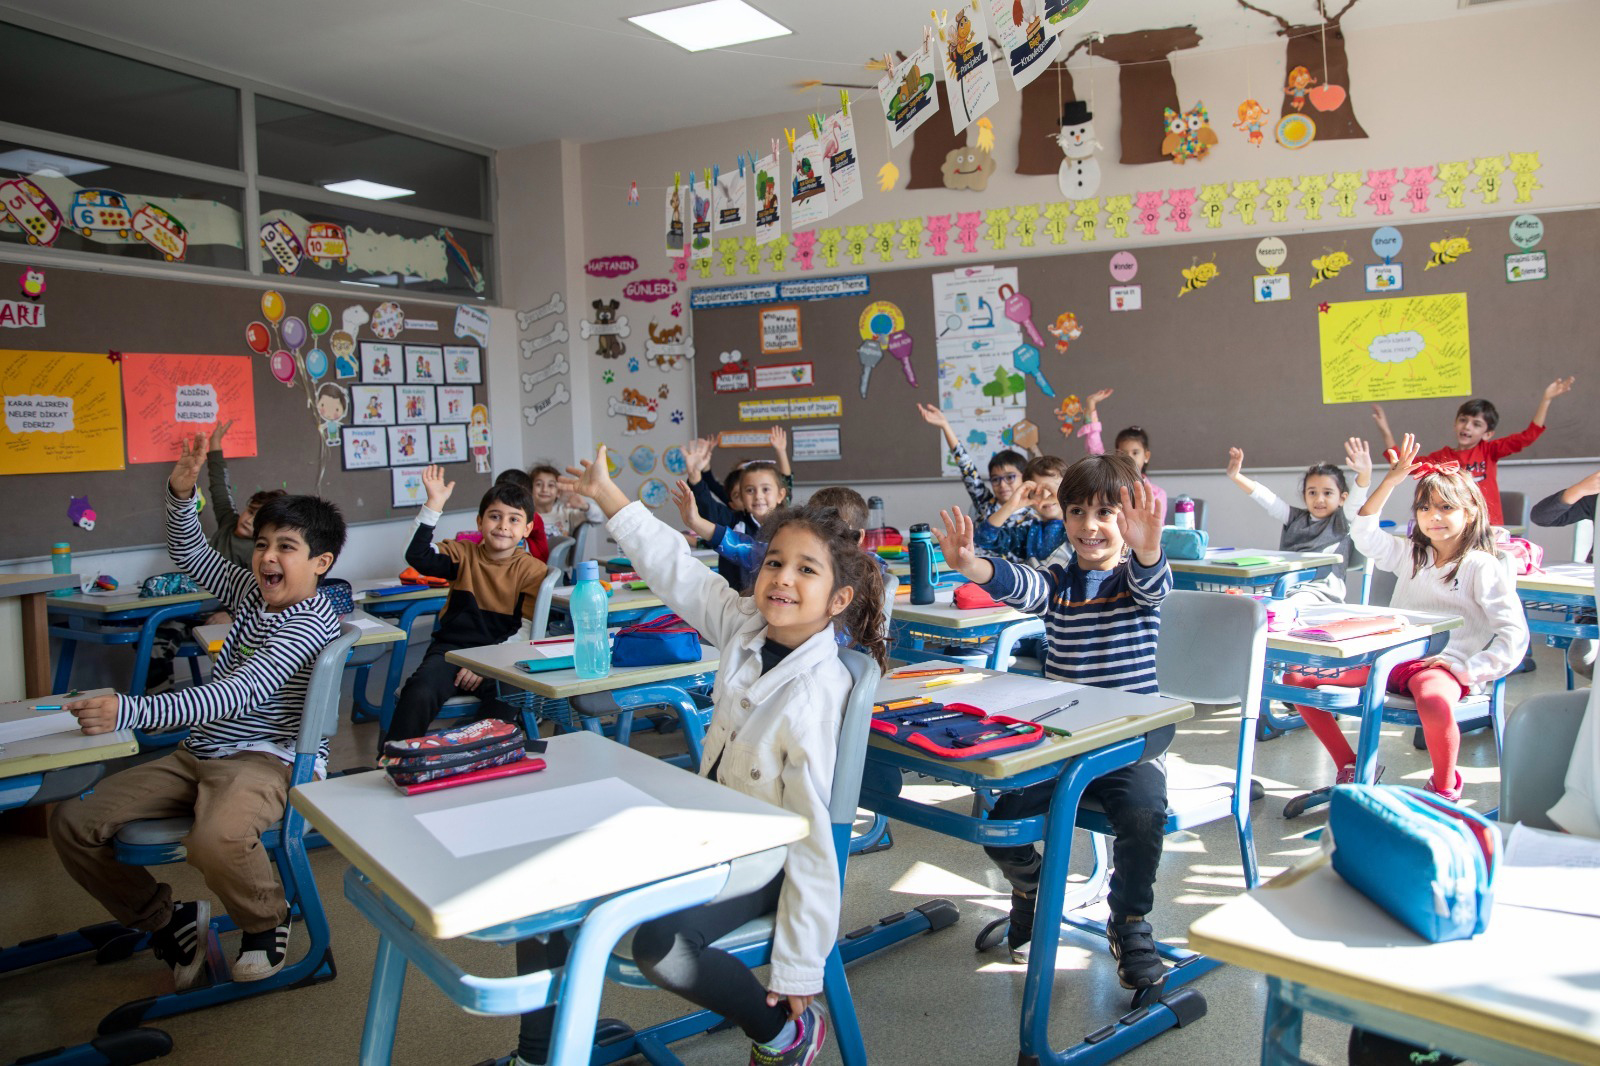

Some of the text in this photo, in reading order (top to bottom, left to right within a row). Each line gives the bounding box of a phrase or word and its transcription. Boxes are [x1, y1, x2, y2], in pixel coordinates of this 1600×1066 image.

[9, 194, 26, 210] 5
[81, 209, 95, 224] 6
[141, 219, 154, 231] 7
[702, 258, 708, 267] b
[775, 250, 782, 260] d
[828, 244, 834, 258] f
[854, 243, 862, 255] g
[881, 237, 889, 252] ğ
[910, 236, 916, 248] h
[1024, 223, 1031, 235] k
[1083, 220, 1094, 228] m
[1146, 213, 1155, 222] o
[1178, 208, 1187, 220] ö
[1211, 204, 1219, 217] p
[1244, 203, 1250, 211] r
[1277, 200, 1282, 208] s
[1379, 193, 1387, 201] u
[1415, 187, 1424, 200] ü
[1451, 186, 1459, 194] v
[1486, 178, 1494, 192] y
[1515, 220, 1538, 228] Reflect
[265, 229, 276, 242] 9
[310, 241, 322, 252] 10
[587, 261, 634, 271] HAFTANIN
[1113, 262, 1134, 270] Wonder
[626, 282, 676, 296] GÜNLERİ
[842, 280, 865, 290] Theme
[750, 290, 771, 299] Tema
[0, 303, 40, 325] ARI
[180, 388, 210, 396] ALDIĞIN
[36, 400, 69, 408] ALIRKEN
[40, 410, 69, 418] DİKKAT
[177, 411, 215, 419] NELERDİR?
[22, 420, 55, 428] EDERİZ?
